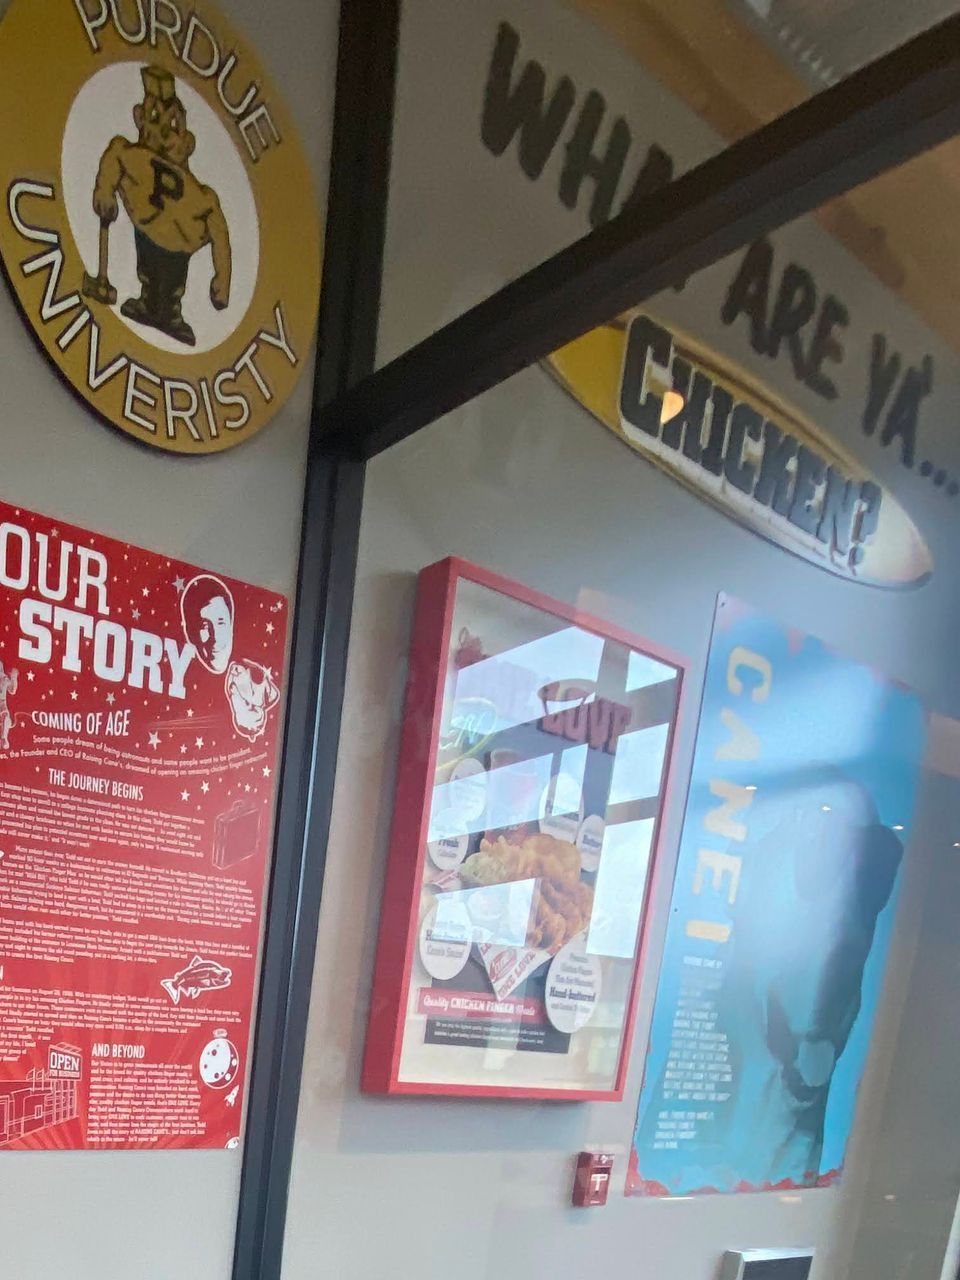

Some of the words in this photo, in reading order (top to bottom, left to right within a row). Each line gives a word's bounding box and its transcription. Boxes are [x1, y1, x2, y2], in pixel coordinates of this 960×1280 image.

[76, 0, 281, 162] PURDUE
[480, 21, 673, 232] WH
[720, 238, 848, 400] ARE
[7, 181, 298, 441] UNIVERISTY
[18, 598, 197, 699] STORY
[31, 710, 81, 733] COMING
[86, 712, 102, 735] OF
[105, 709, 130, 736] AGE
[10, 749, 20, 758] the
[21, 747, 45, 757] Founder
[60, 748, 74, 757] CEO
[48, 767, 66, 788] THE
[68, 772, 110, 796] JOURNEY
[112, 780, 144, 801] BEGINS
[693, 646, 773, 904] CANE
[450, 997, 486, 1012] CHICKEN
[50, 1051, 80, 1071] OPEN
[92, 1043, 110, 1058] AND
[112, 1044, 145, 1059] BEYOND
